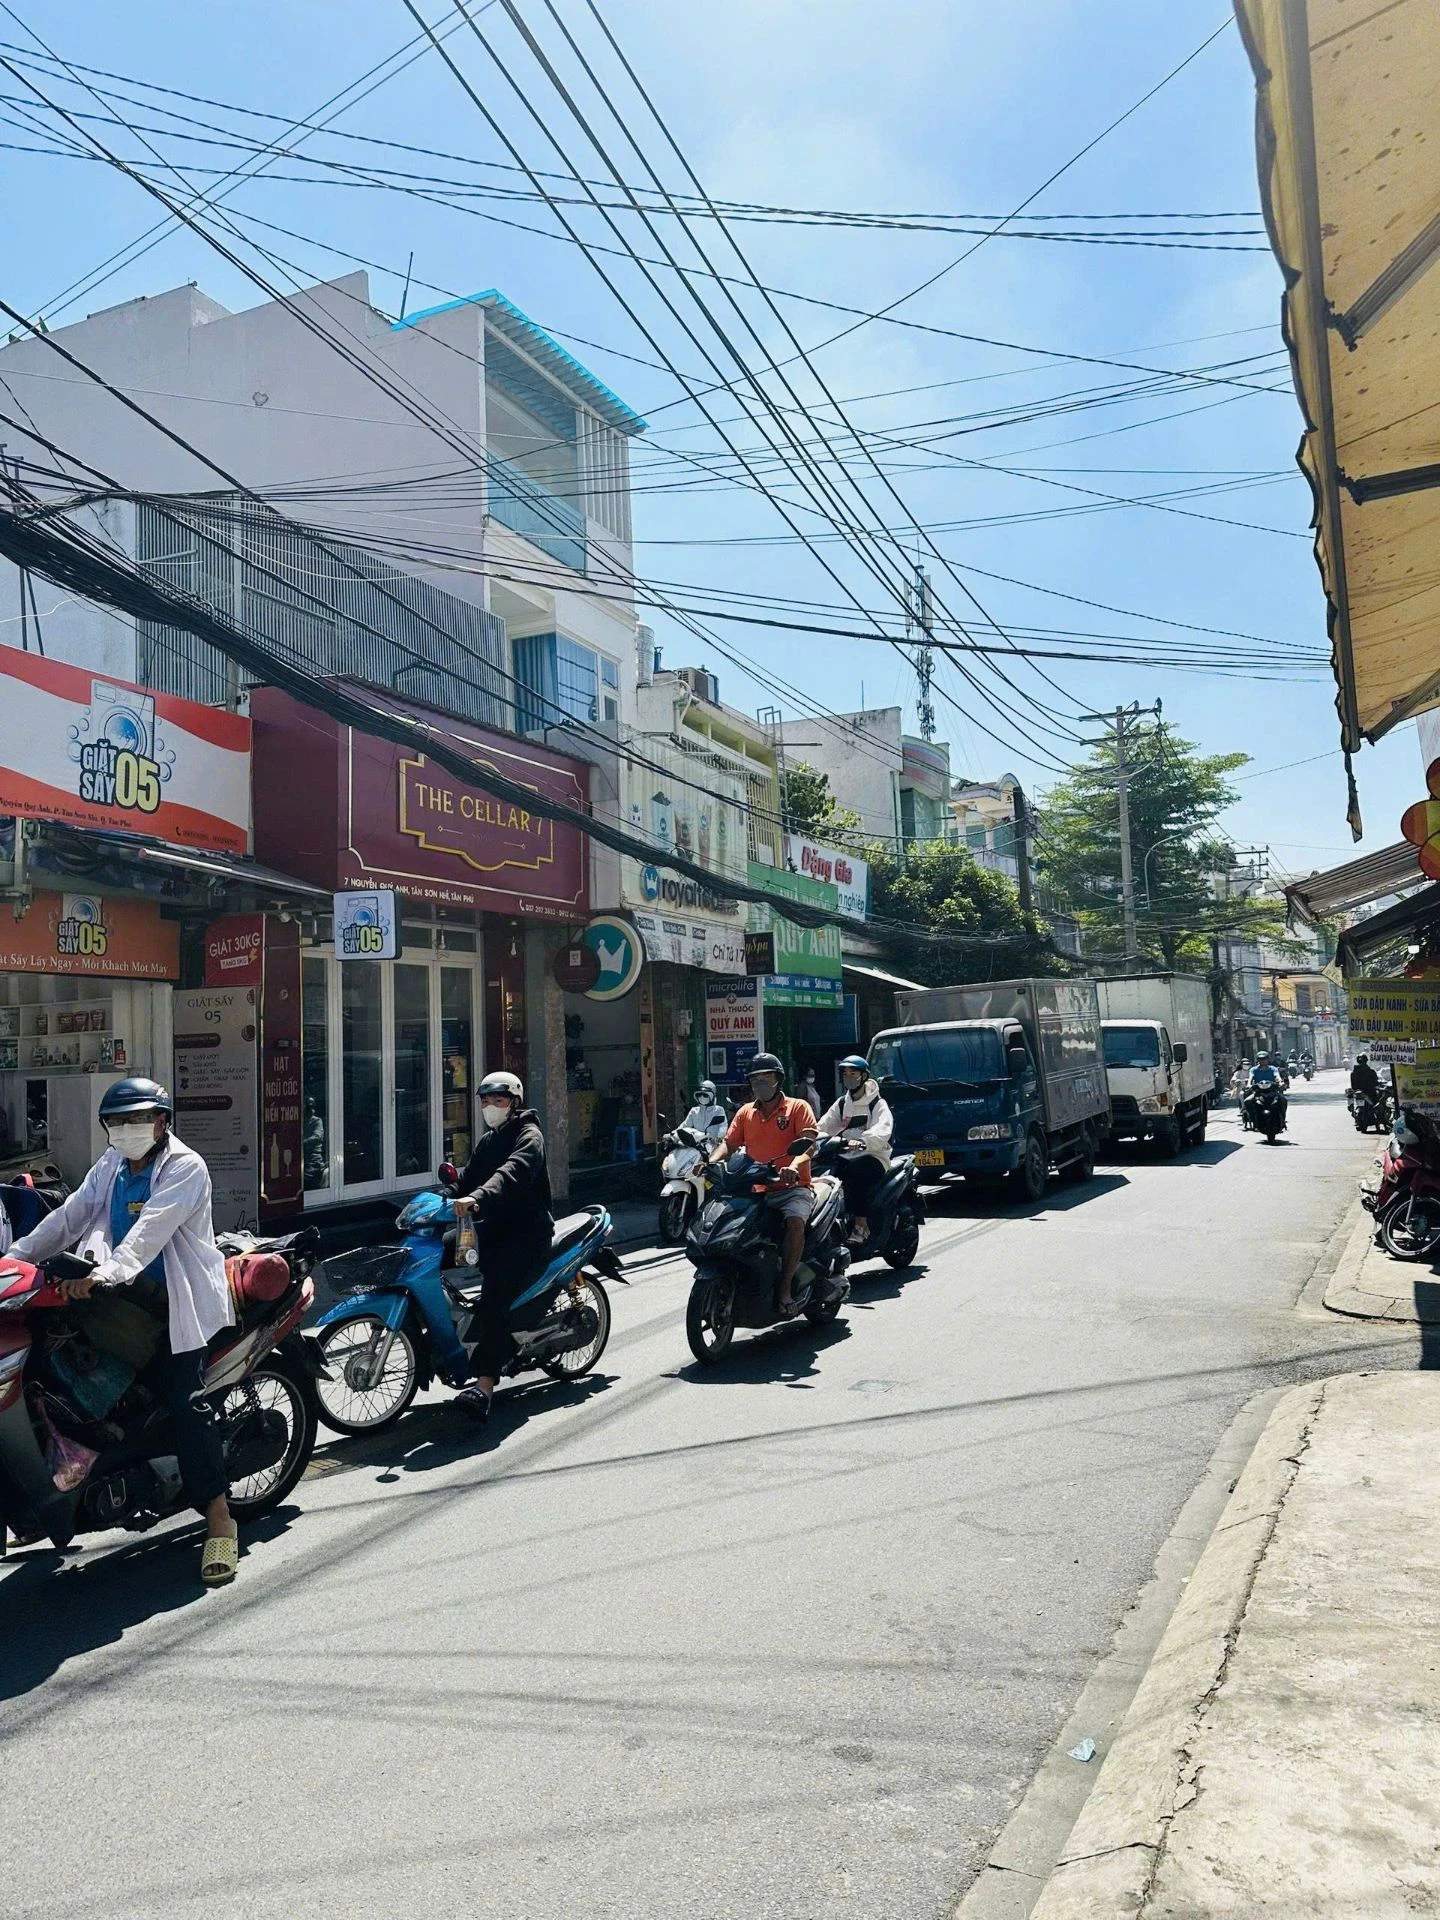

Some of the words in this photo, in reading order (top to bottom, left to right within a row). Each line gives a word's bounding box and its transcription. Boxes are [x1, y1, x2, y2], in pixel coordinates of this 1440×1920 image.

[82, 741, 117, 774] GIẶT
[116, 750, 160, 812] 05
[415, 782, 454, 814] THE
[460, 795, 530, 833] CELLAR
[536, 816, 543, 835] 7
[802, 846, 832, 882] Đặng
[835, 858, 852, 884] Gia
[79, 922, 107, 956] 05
[234, 932, 260, 951] 30KG
[360, 926, 382, 952] 05
[50, 956, 73, 972] Ngay
[710, 978, 754, 992] microlife
[204, 1010, 222, 1024] 05
[728, 1003, 754, 1012] THUỐC
[710, 1015, 730, 1030] QUÝ
[733, 1017, 755, 1030] ANH
[1384, 1020, 1404, 1032] XANH
